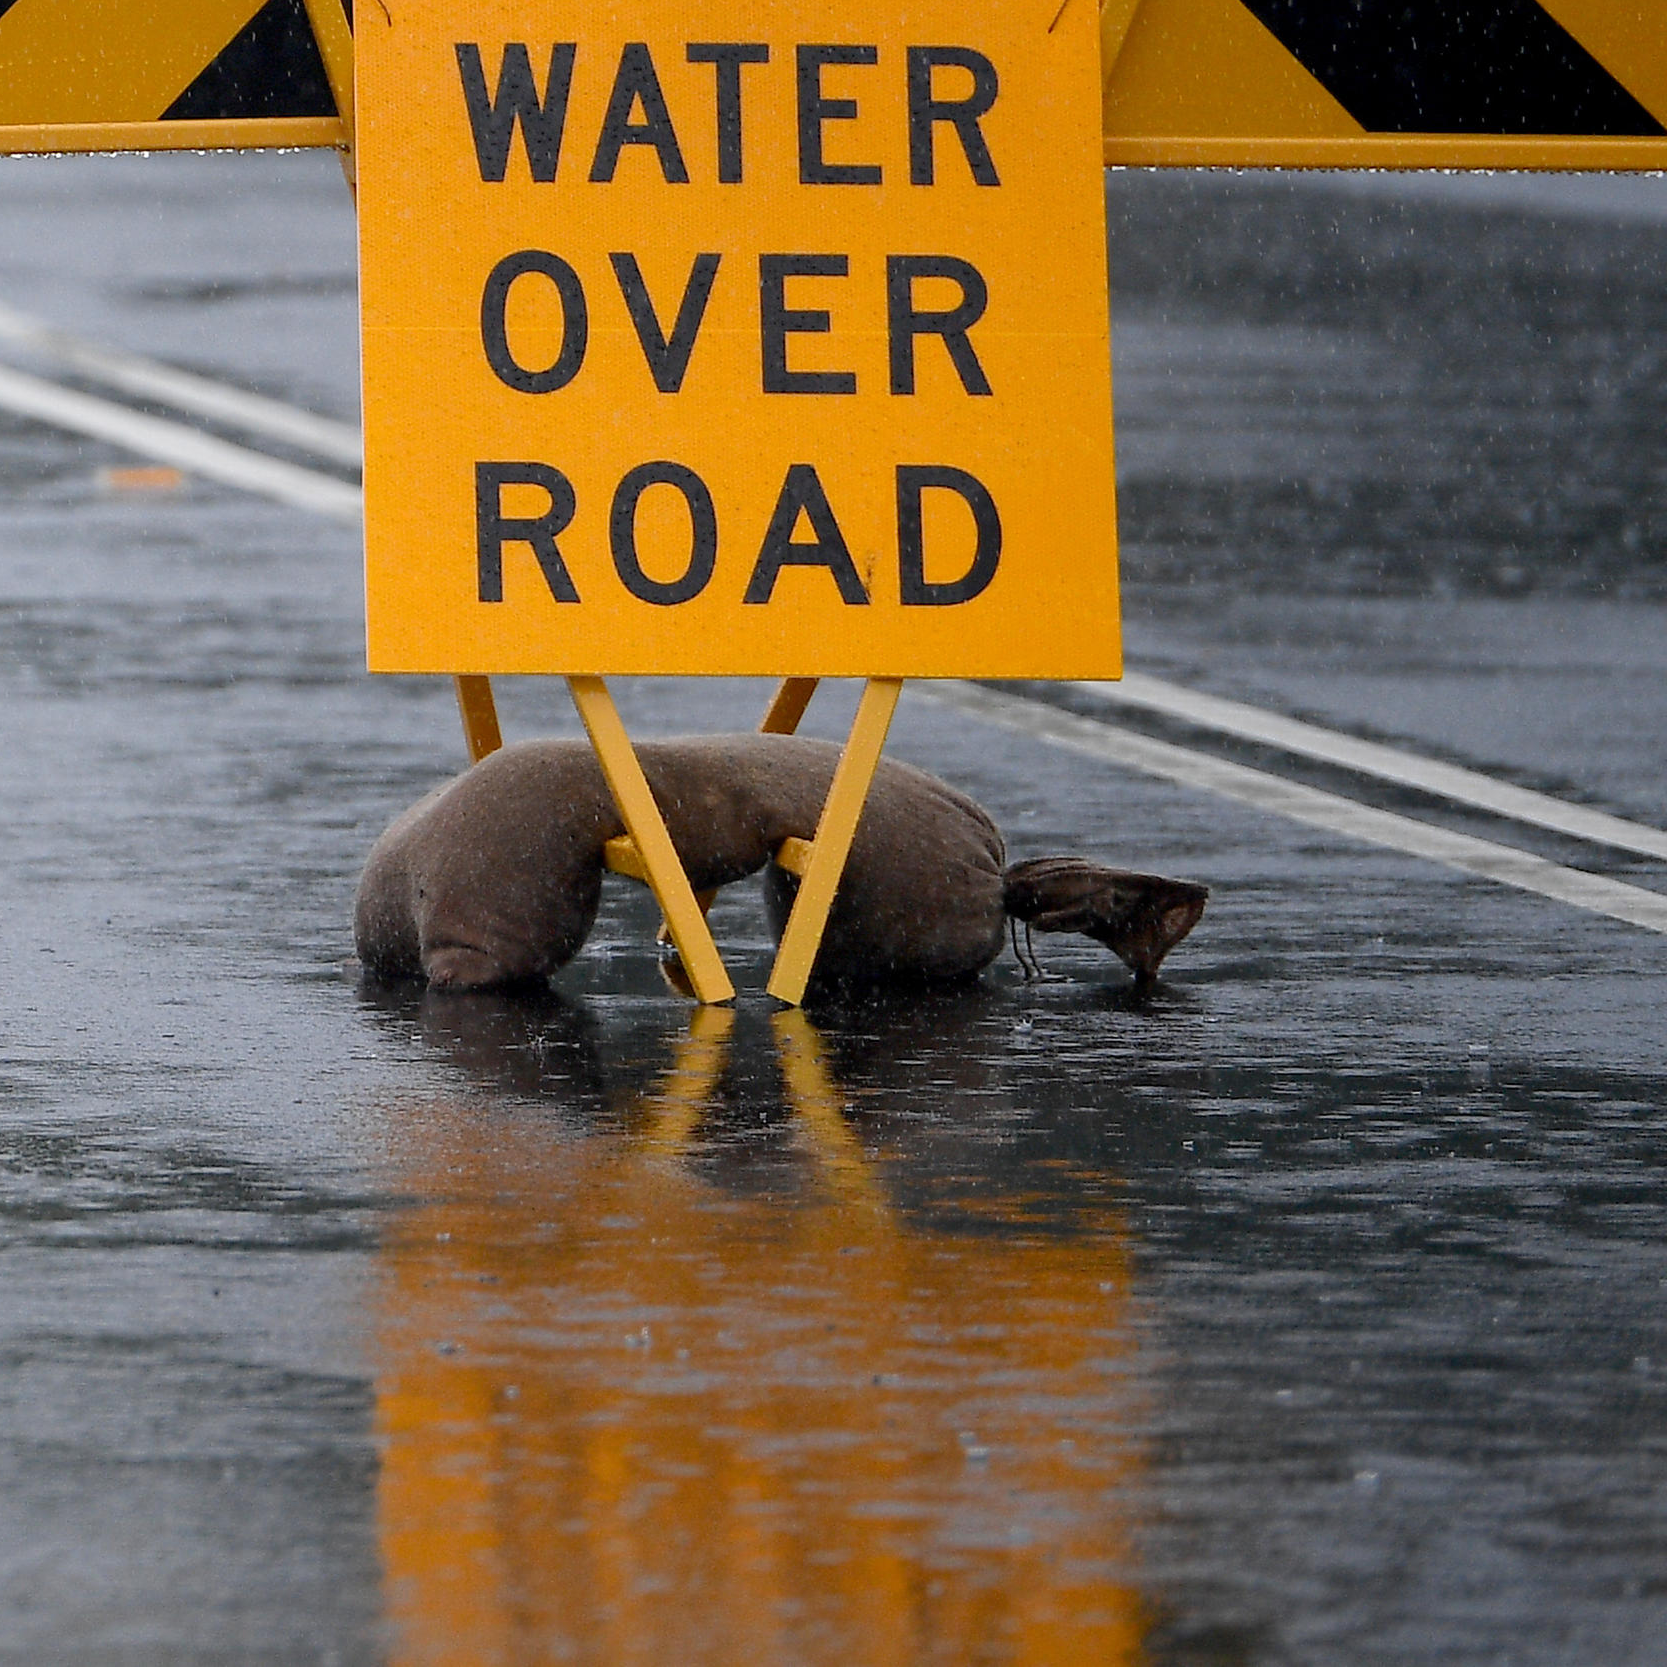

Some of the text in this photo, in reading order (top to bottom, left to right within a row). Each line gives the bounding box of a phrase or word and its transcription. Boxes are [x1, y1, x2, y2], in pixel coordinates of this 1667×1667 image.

[455, 43, 1000, 186] WATER
[481, 250, 993, 395] OVER
[476, 461, 1002, 606] ROAD
